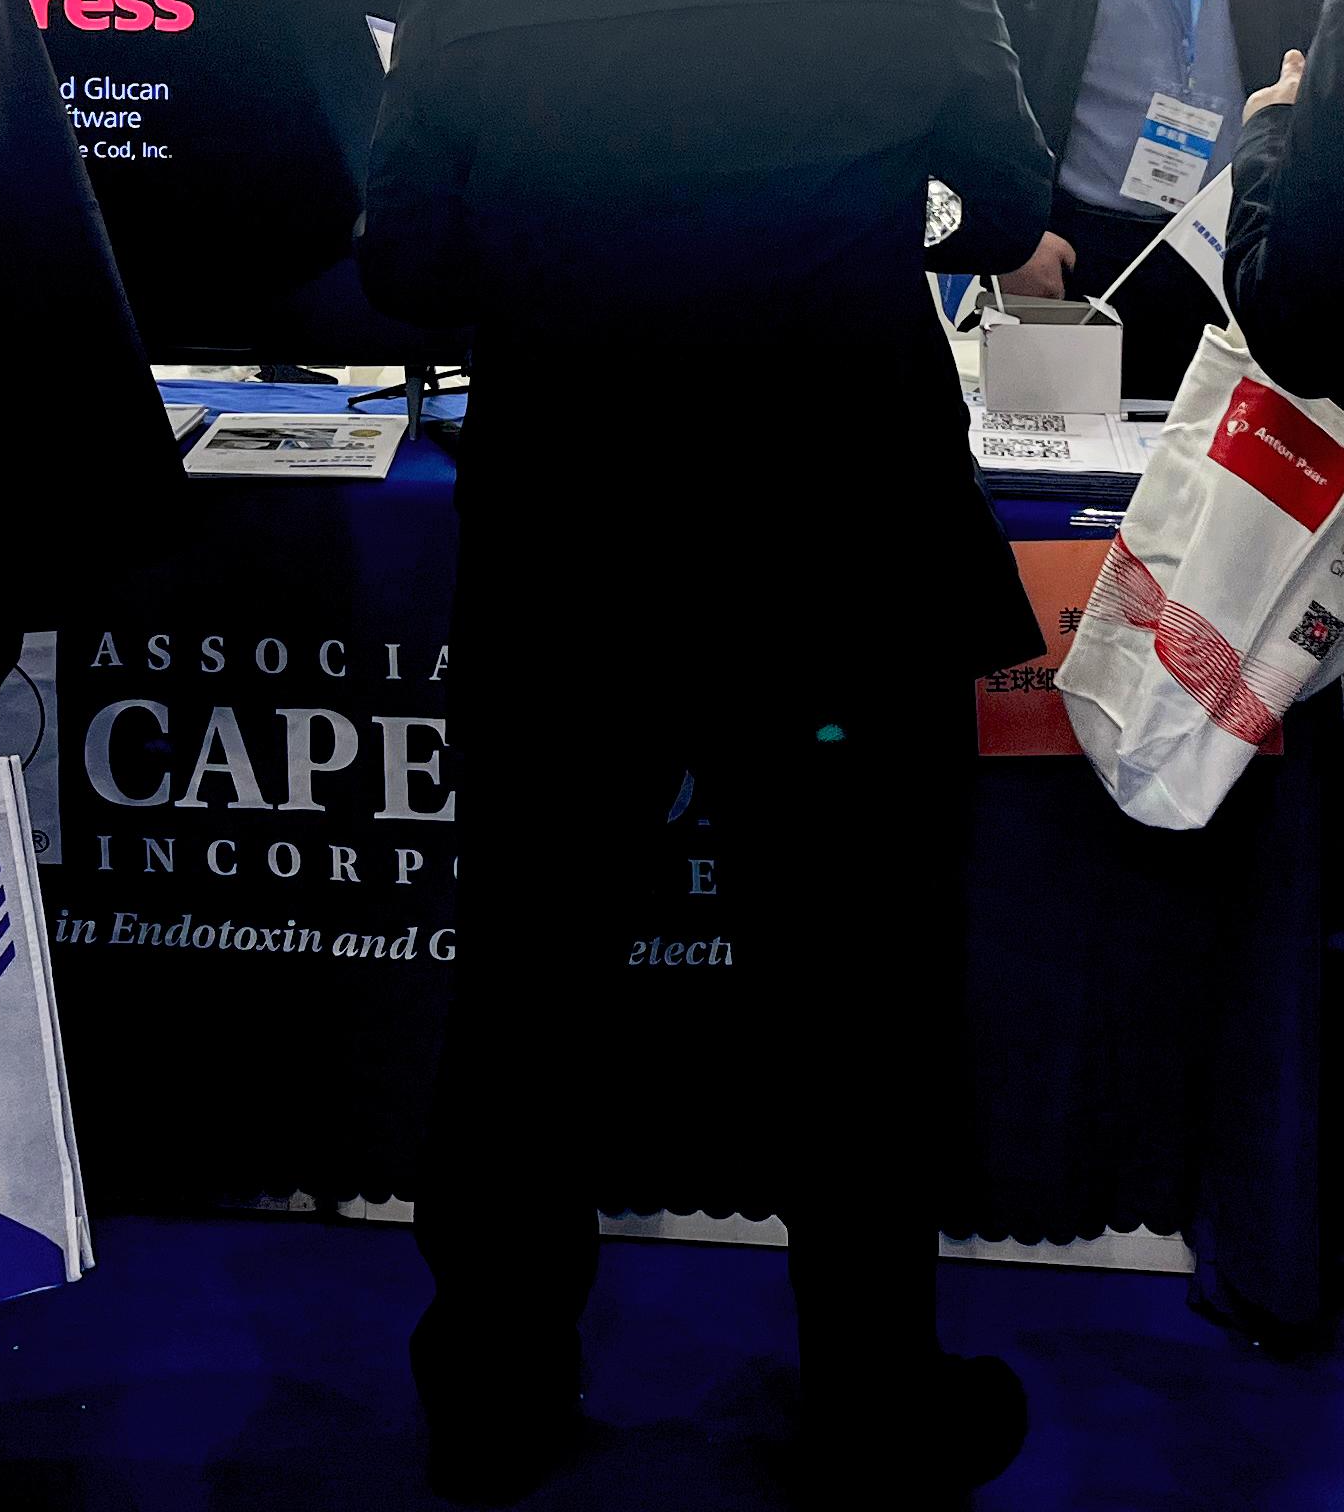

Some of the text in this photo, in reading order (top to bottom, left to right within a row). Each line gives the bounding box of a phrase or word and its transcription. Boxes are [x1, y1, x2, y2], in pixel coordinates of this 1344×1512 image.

[84, 76, 169, 101] Glucan
[67, 105, 142, 129] tware
[93, 141, 136, 161] Cod,
[142, 142, 172, 159] Inc.
[1254, 426, 1328, 486] Anton Paar
[90, 630, 449, 682] ASSOCIA
[83, 698, 456, 824] CAPE
[56, 908, 96, 947] in
[109, 910, 323, 956] Endotoxin
[331, 924, 418, 961] and
